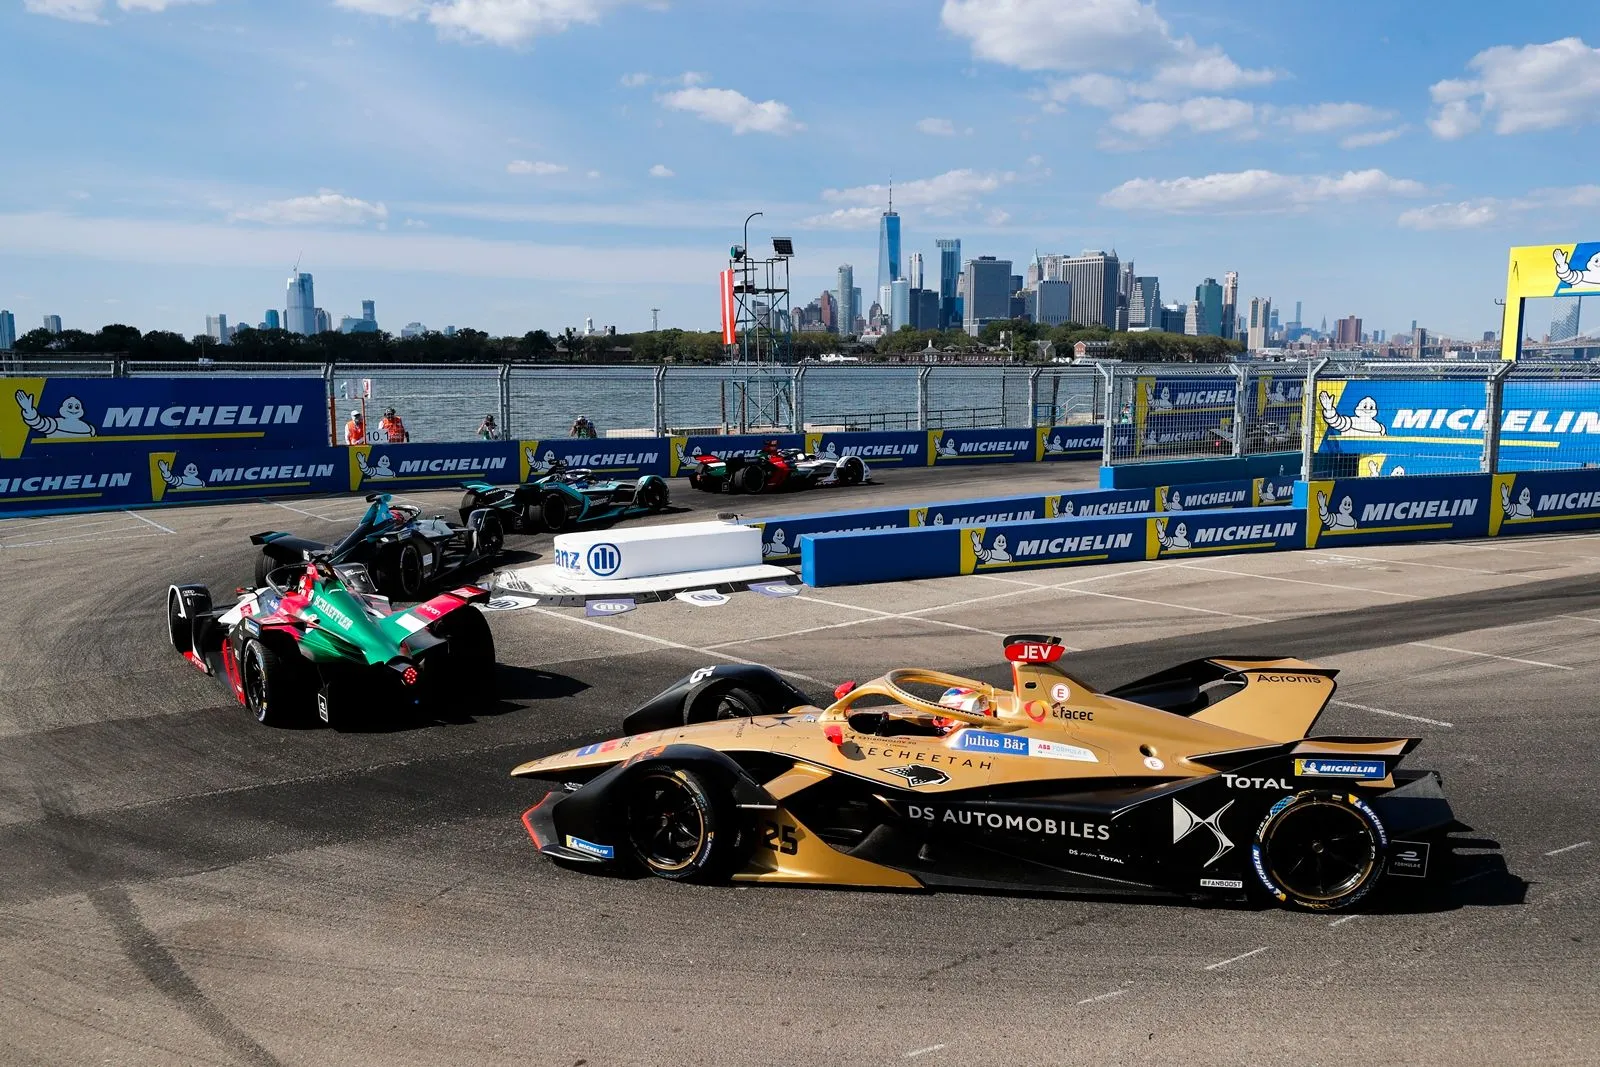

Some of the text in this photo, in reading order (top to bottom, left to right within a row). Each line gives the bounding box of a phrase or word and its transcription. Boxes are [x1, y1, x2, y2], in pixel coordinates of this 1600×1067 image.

[1175, 389, 1238, 405] MICHEL
[102, 405, 303, 428] MICHELIN
[366, 431, 389, 442] 10.1
[842, 443, 919, 457] MICHELIN
[960, 440, 1029, 453] MICHELIN
[398, 457, 507, 474] MICHELIN
[565, 452, 659, 467] MICHELIN
[209, 464, 335, 482] MICHELIN
[1184, 490, 1246, 507] MICHELIN
[1079, 499, 1151, 516] MICHELIN
[1360, 498, 1478, 522] MICHELIN
[1194, 522, 1298, 543] MICHELIN
[1015, 533, 1133, 556] MICHELIN
[312, 595, 354, 632] SCHAEFFLER
[420, 604, 441, 616] e-tron
[1018, 645, 1052, 660] JEV
[1257, 673, 1322, 684] Acronis
[1057, 688, 1064, 698] E
[964, 734, 1026, 751] Julius Bär
[854, 746, 992, 770] TECHEETAH
[1320, 763, 1377, 773] MICHELIN
[1221, 773, 1294, 790] TOTAL
[908, 805, 1111, 841] DS AUTOMOBILES
[1362, 805, 1387, 845] MICHELIN
[763, 820, 798, 856] 25
[578, 842, 608, 856] MICHELIN
[1068, 848, 1079, 856] DS
[1099, 854, 1125, 865] TOTAL
[1253, 849, 1275, 890] MICHELIN
